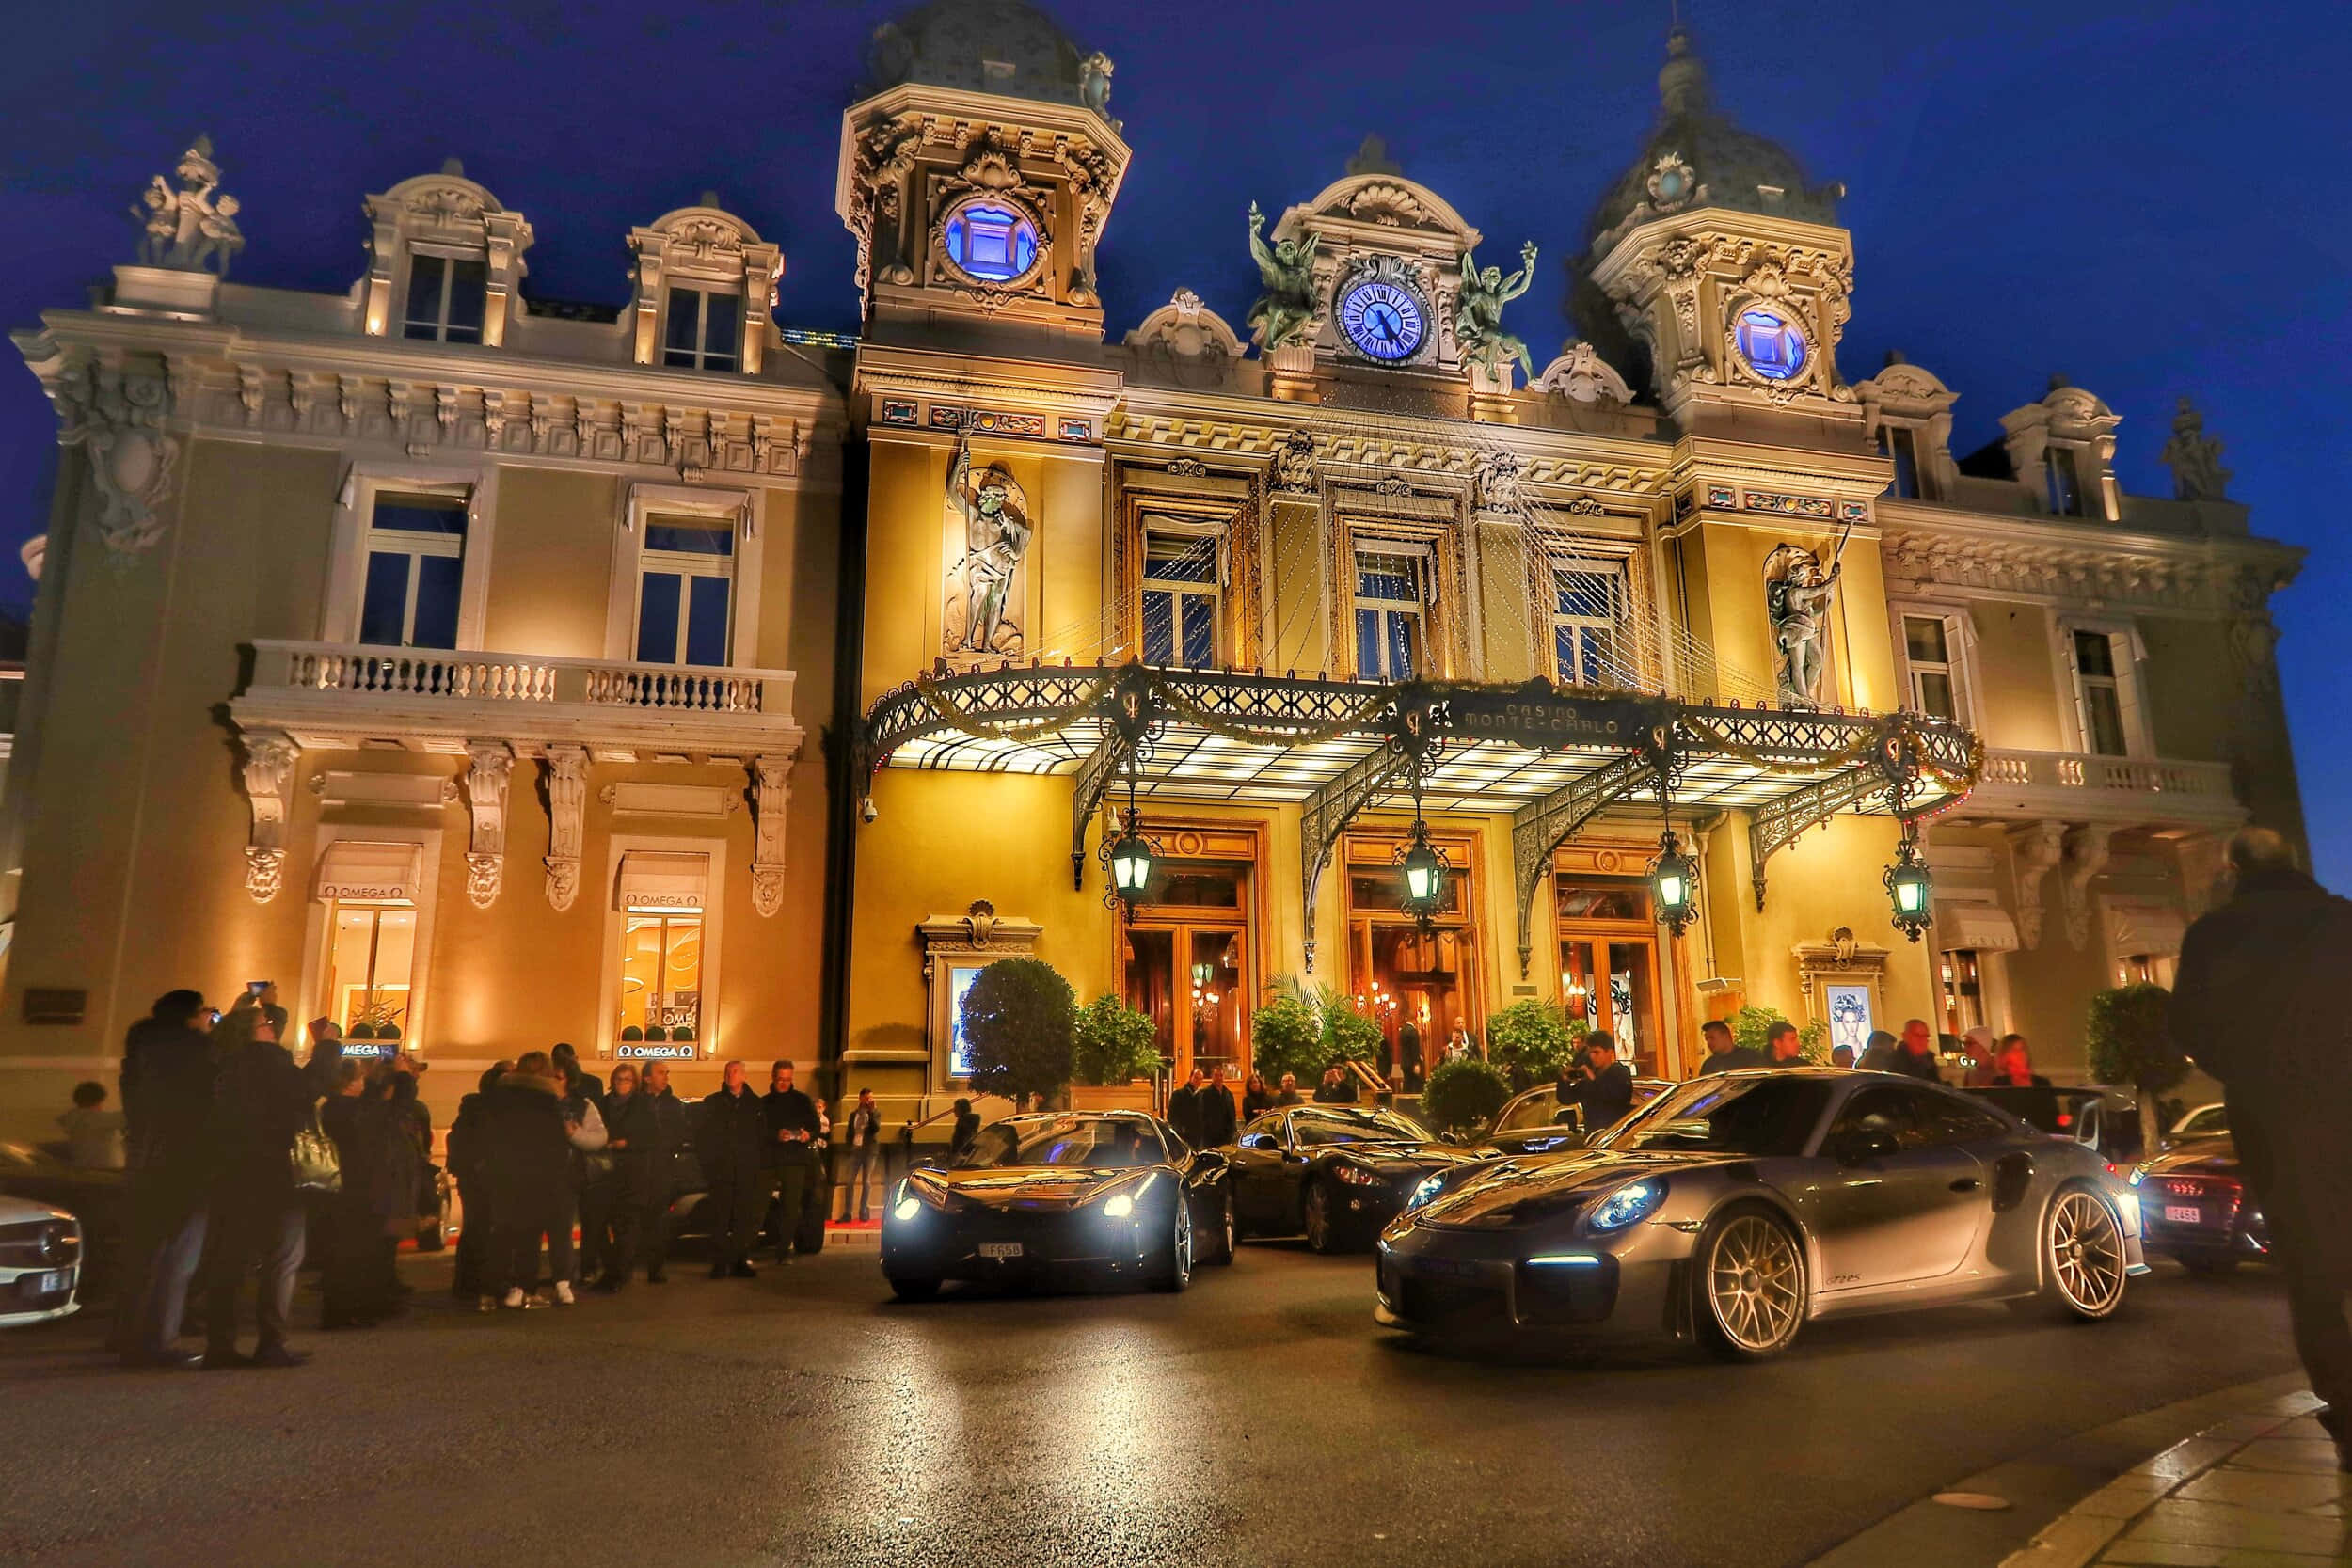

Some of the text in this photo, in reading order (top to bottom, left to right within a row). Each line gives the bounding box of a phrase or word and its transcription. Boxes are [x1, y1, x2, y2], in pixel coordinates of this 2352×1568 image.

[340, 887, 386, 897] OMEGA
[640, 895, 682, 905] OMEGA
[342, 1044, 380, 1055] MEGA
[633, 1047, 678, 1057] OMEGA
